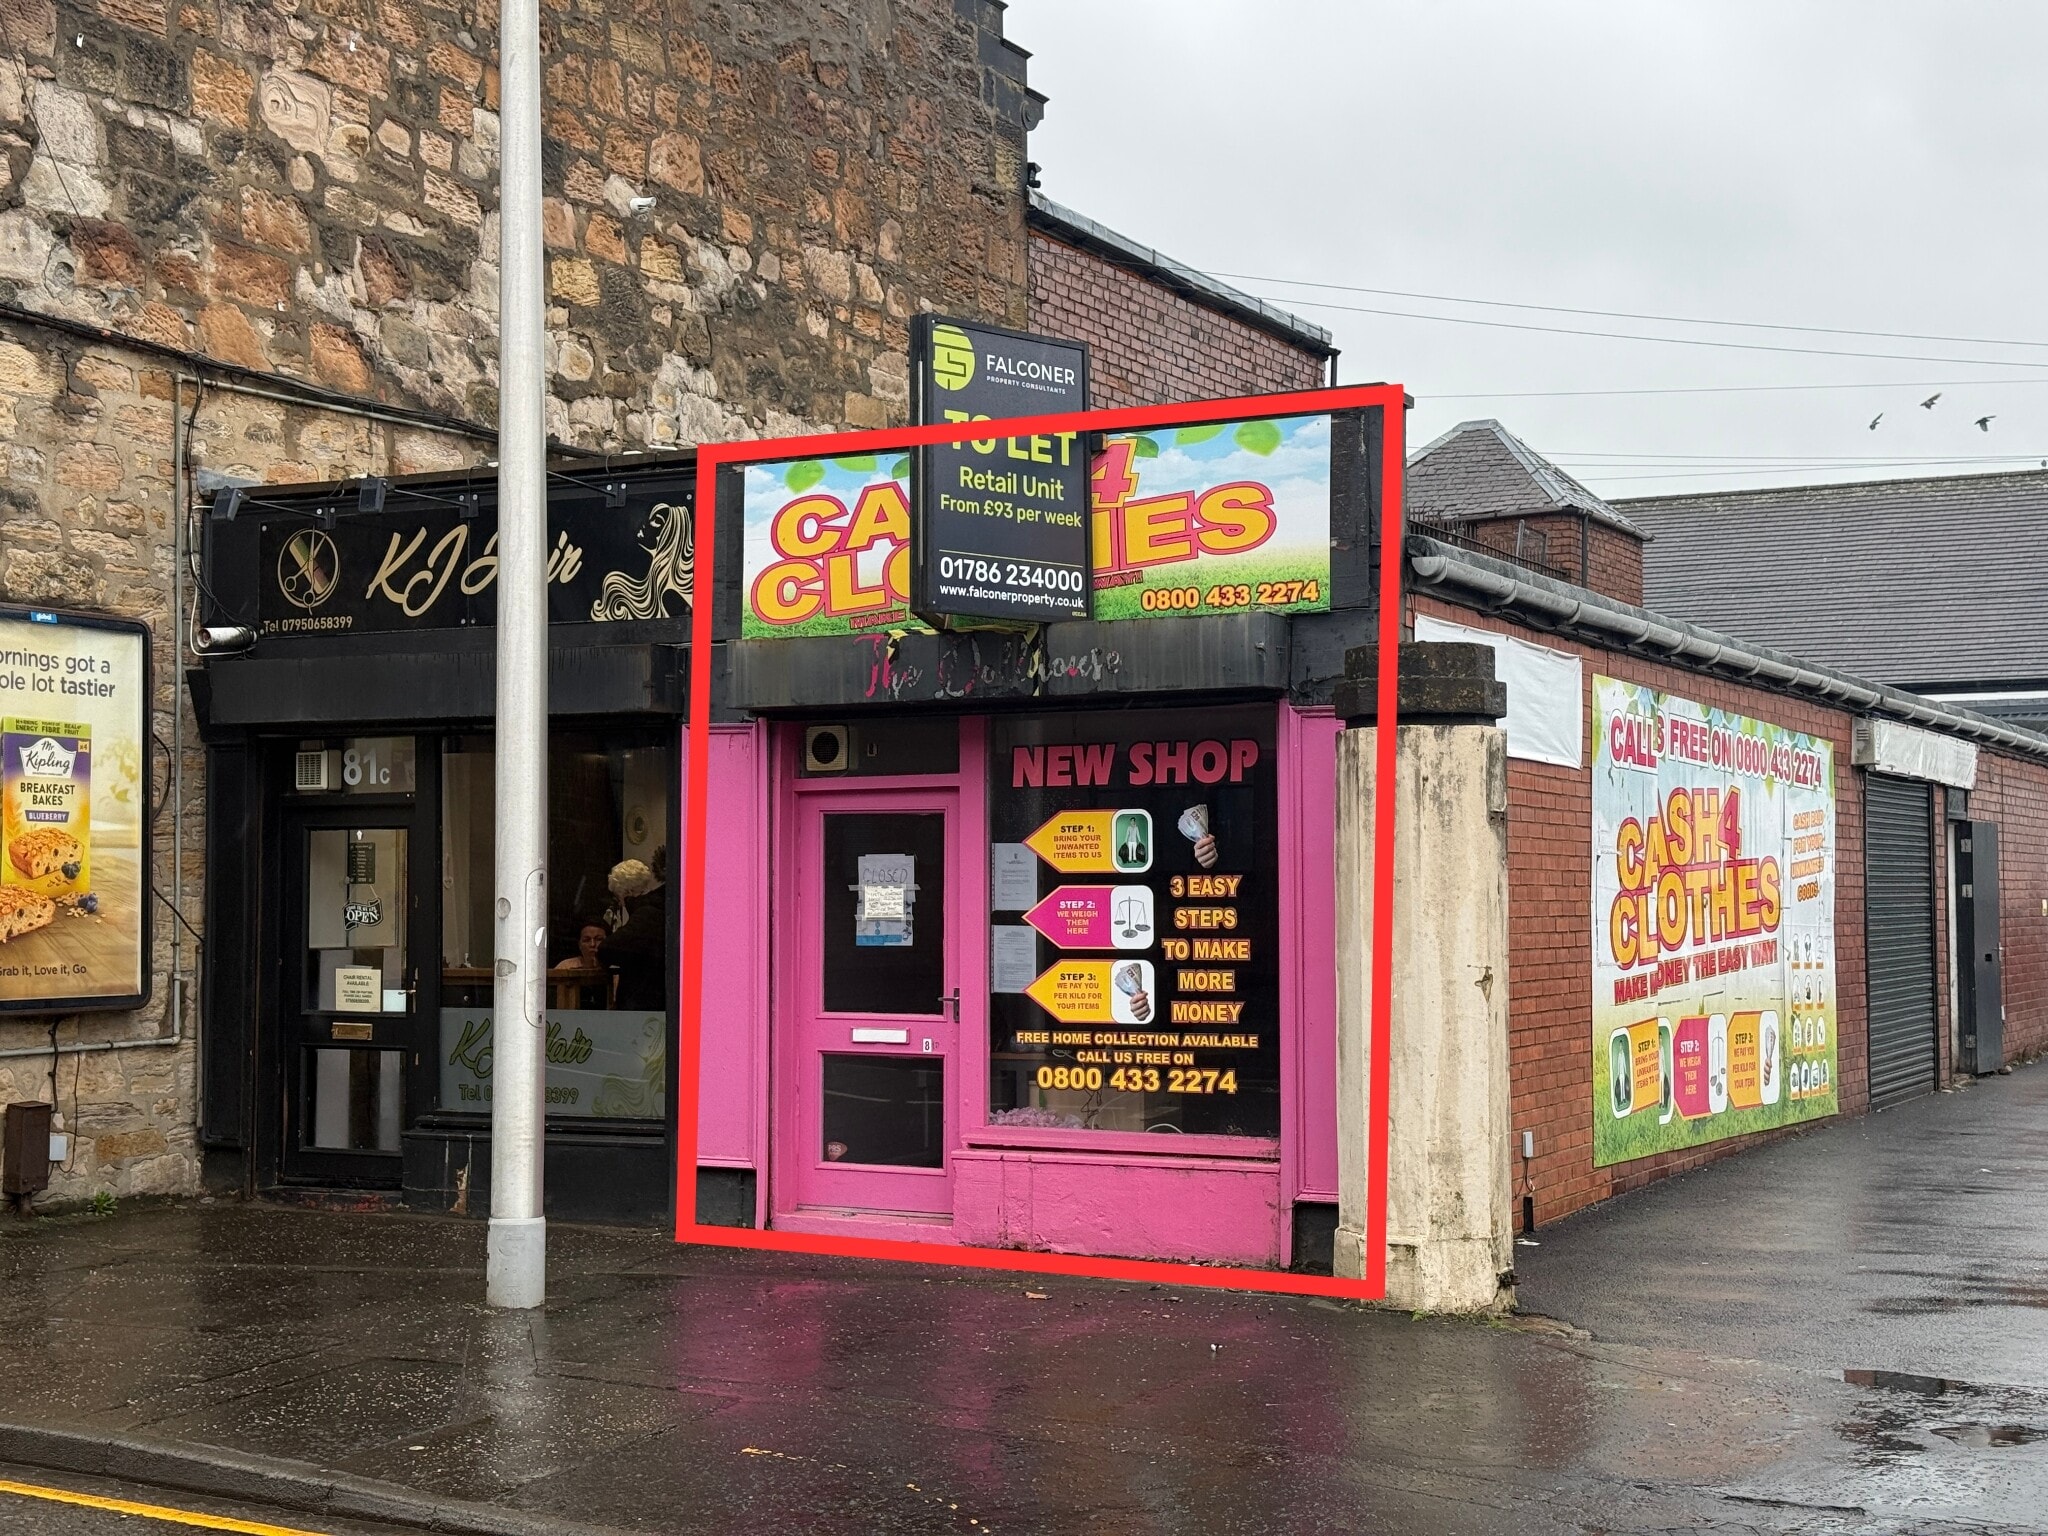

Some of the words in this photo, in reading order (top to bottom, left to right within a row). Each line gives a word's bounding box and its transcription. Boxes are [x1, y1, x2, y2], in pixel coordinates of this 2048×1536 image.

[986, 354, 1076, 386] FALCONER
[986, 376, 1020, 387] PROPERTY
[1021, 381, 1066, 395] CONSULTANTS
[944, 409, 997, 455] TO
[1007, 431, 1077, 467] LET
[959, 465, 1018, 495] Retail
[1022, 474, 1065, 501] Unit
[770, 481, 910, 560] CA
[940, 494, 980, 514] From
[983, 499, 1014, 519] £93
[1016, 507, 1042, 524] per
[1044, 511, 1082, 528] week
[365, 523, 468, 617] KJ
[940, 556, 1002, 583] 01786
[1005, 564, 1083, 592] 234000
[939, 585, 1084, 608] www.falconerproperty.co.uk
[1141, 586, 1200, 611] 0800
[1205, 584, 1251, 608] 433
[1256, 579, 1320, 604] 2274
[263, 620, 280, 633] Tel
[281, 615, 353, 631] 07950658399
[849, 609, 906, 630] MAKE
[65, 655, 95, 675] got
[101, 660, 111, 675] a
[32, 672, 55, 693] lot
[60, 676, 116, 698] tastier
[41, 740, 54, 752] Mr
[1669, 718, 1709, 764] FREE
[1711, 730, 1733, 769] ON
[1735, 735, 1768, 778] 0800
[1770, 743, 1792, 782] 433
[1794, 751, 1822, 786] 2274
[25, 750, 71, 774] Kipling
[1011, 743, 1117, 788] NEW
[1128, 738, 1260, 787] SHOP
[20, 782, 76, 795] BREAKFAST
[32, 794, 63, 806] BAKES
[28, 811, 67, 821] BLUEBERRY
[1060, 825, 1084, 833] STEP
[1087, 825, 1095, 833] 1:
[1080, 834, 1102, 842] YOUR
[1056, 843, 1100, 851] UNWANTED
[863, 867, 908, 885] CLOSED
[1170, 875, 1185, 898] 3
[1187, 875, 1243, 898] EASY
[1057, 910, 1069, 918] WE
[1071, 910, 1099, 918] WEIGH
[1059, 900, 1084, 909] STEP
[1086, 900, 1096, 909] 2:
[1610, 856, 1781, 971] CLOTHES
[346, 910, 379, 923] OPEN
[1174, 906, 1238, 930] STEPS
[1066, 927, 1089, 935] HERE
[1161, 938, 1190, 961] TO
[1192, 938, 1251, 961] MAKE
[22, 964, 32, 978] it,
[34, 964, 58, 976] Love
[60, 963, 70, 977] it,
[72, 963, 87, 975] Go
[1060, 973, 1085, 981] STEP
[1177, 969, 1236, 992] MORE
[1614, 972, 1648, 1006] MAKE
[1692, 950, 1717, 981] THE
[1718, 945, 1749, 976] EASY
[1750, 937, 1778, 968] WAY!
[1171, 1000, 1245, 1024] MONEY
[1015, 1031, 1050, 1044] FREE
[1052, 1032, 1092, 1045] HOME
[1094, 1032, 1180, 1047] COLLECTION
[1181, 1034, 1259, 1048] AVAILABLE
[1637, 1039, 1650, 1053] STEP
[1680, 1040, 1694, 1054] STEP
[1735, 1032, 1748, 1045] STEP
[1076, 1050, 1111, 1063] CALL
[1114, 1051, 1133, 1064] US
[1135, 1052, 1170, 1065] FREE
[1173, 1053, 1194, 1065] ON
[1036, 1065, 1104, 1091] 0800
[1109, 1066, 1161, 1093] 433
[1167, 1068, 1238, 1094] 2274
[459, 1084, 481, 1101] Tel
